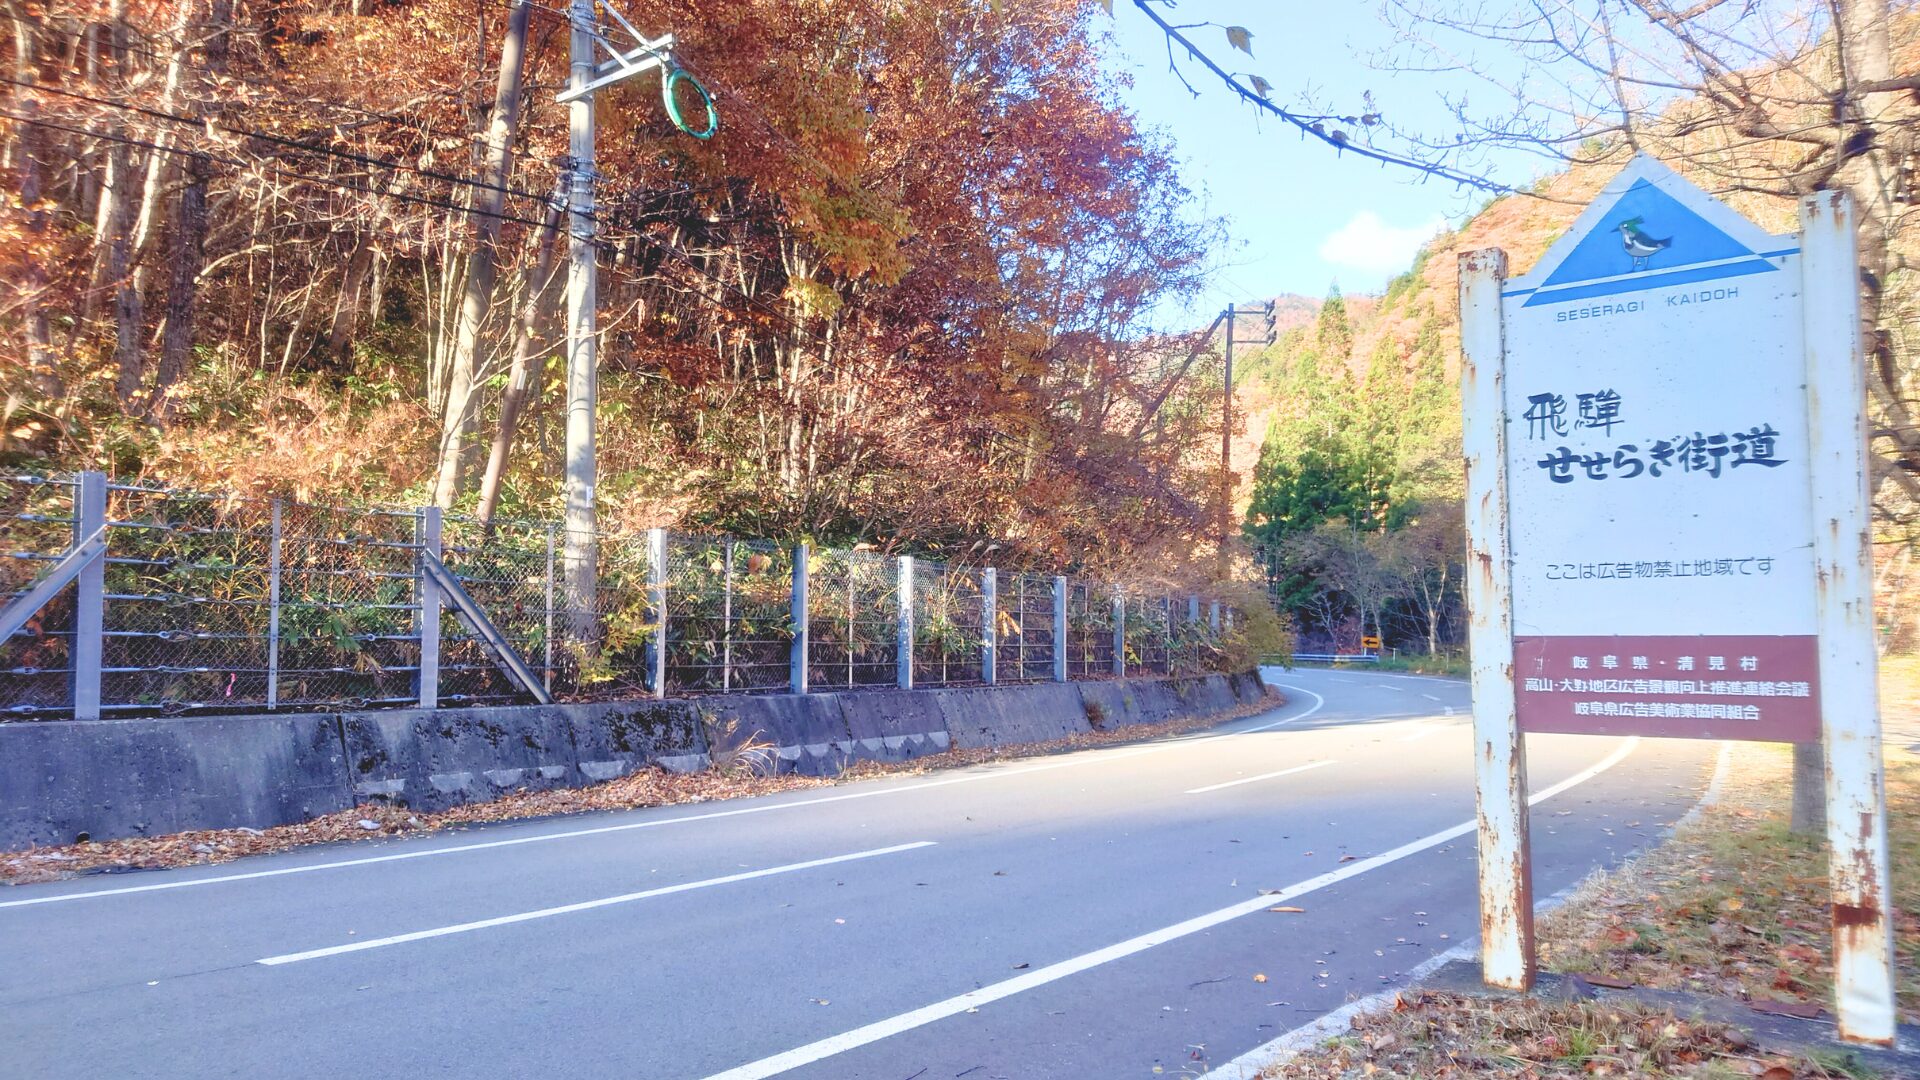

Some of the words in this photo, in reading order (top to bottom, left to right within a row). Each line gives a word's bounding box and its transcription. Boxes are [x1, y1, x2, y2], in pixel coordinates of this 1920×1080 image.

[1557, 300, 1645, 322] SESERAGI
[1667, 287, 1739, 307] KAIDOH
[1537, 424, 1789, 483] せせらぎ街道
[1545, 556, 1775, 580] ここは広告物禁止地域です
[1575, 702, 1760, 720] 岐阜県広告美術業協同組合
